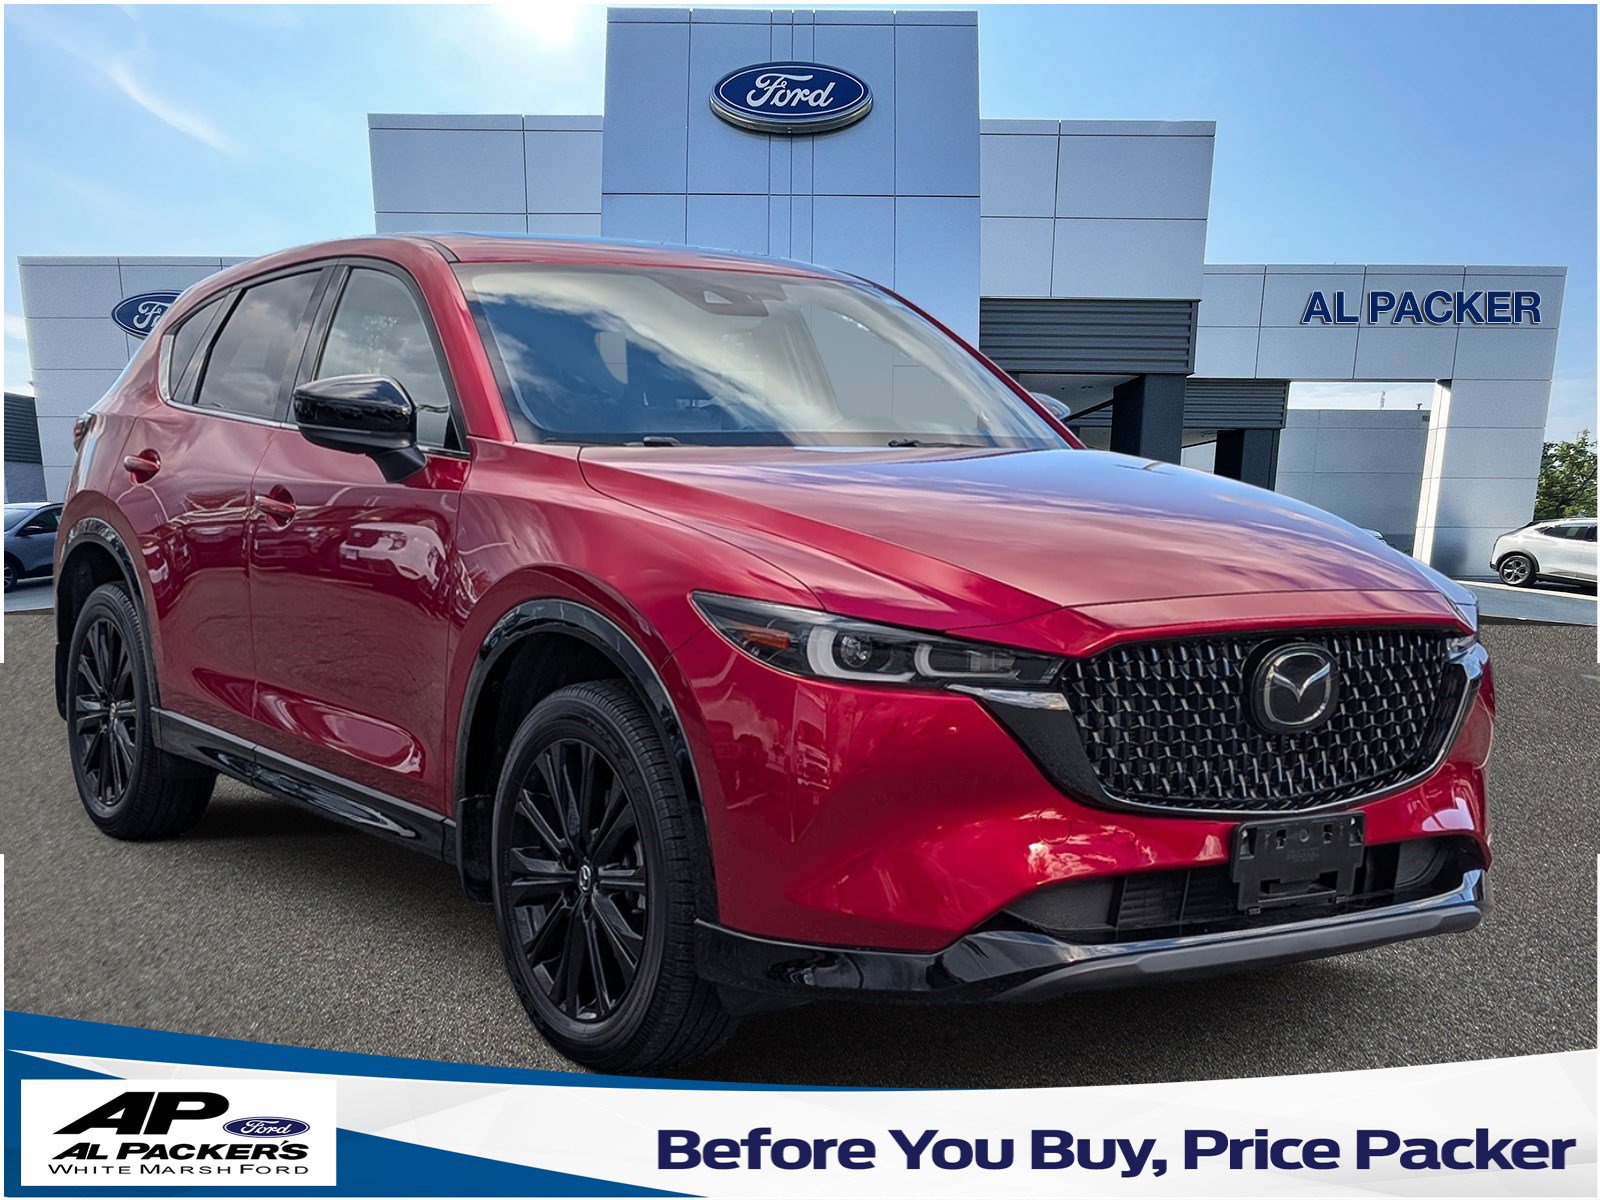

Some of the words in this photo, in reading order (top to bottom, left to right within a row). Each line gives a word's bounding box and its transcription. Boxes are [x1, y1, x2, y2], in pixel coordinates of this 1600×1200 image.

[746, 72, 836, 107] Ford
[1302, 290, 1359, 324] AL
[1369, 289, 1542, 324] PACKER
